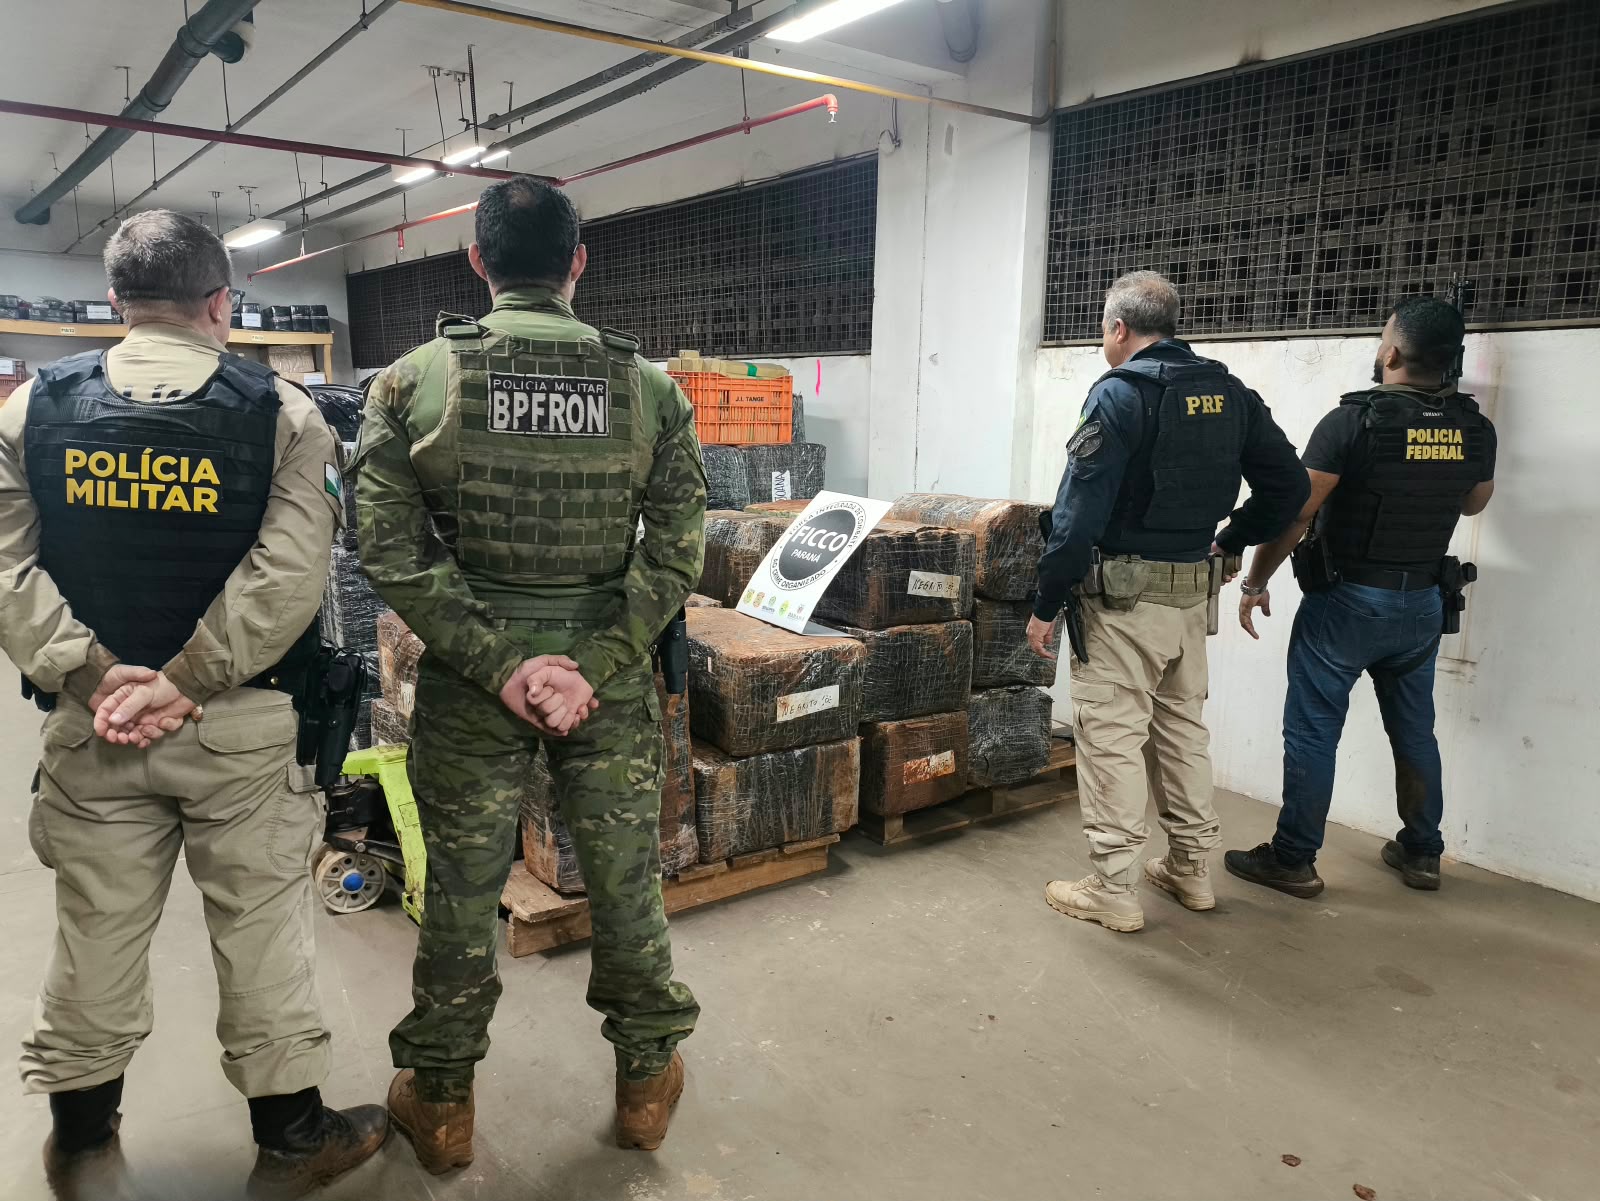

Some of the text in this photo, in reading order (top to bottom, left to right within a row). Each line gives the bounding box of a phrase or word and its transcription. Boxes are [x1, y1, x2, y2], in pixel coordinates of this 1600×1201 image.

[554, 381, 605, 394] MILITAR
[493, 390, 605, 433] BPFRON
[1185, 394, 1225, 416] PRF
[1407, 428, 1463, 444] POLICIA
[1406, 445, 1464, 460] FEDERAL
[65, 447, 221, 485] POLÍCIA
[66, 477, 219, 513] MILITAR
[791, 525, 849, 552] FICCO
[790, 548, 823, 563] PARANÁ
[780, 569, 826, 589] ORGANIZADO
